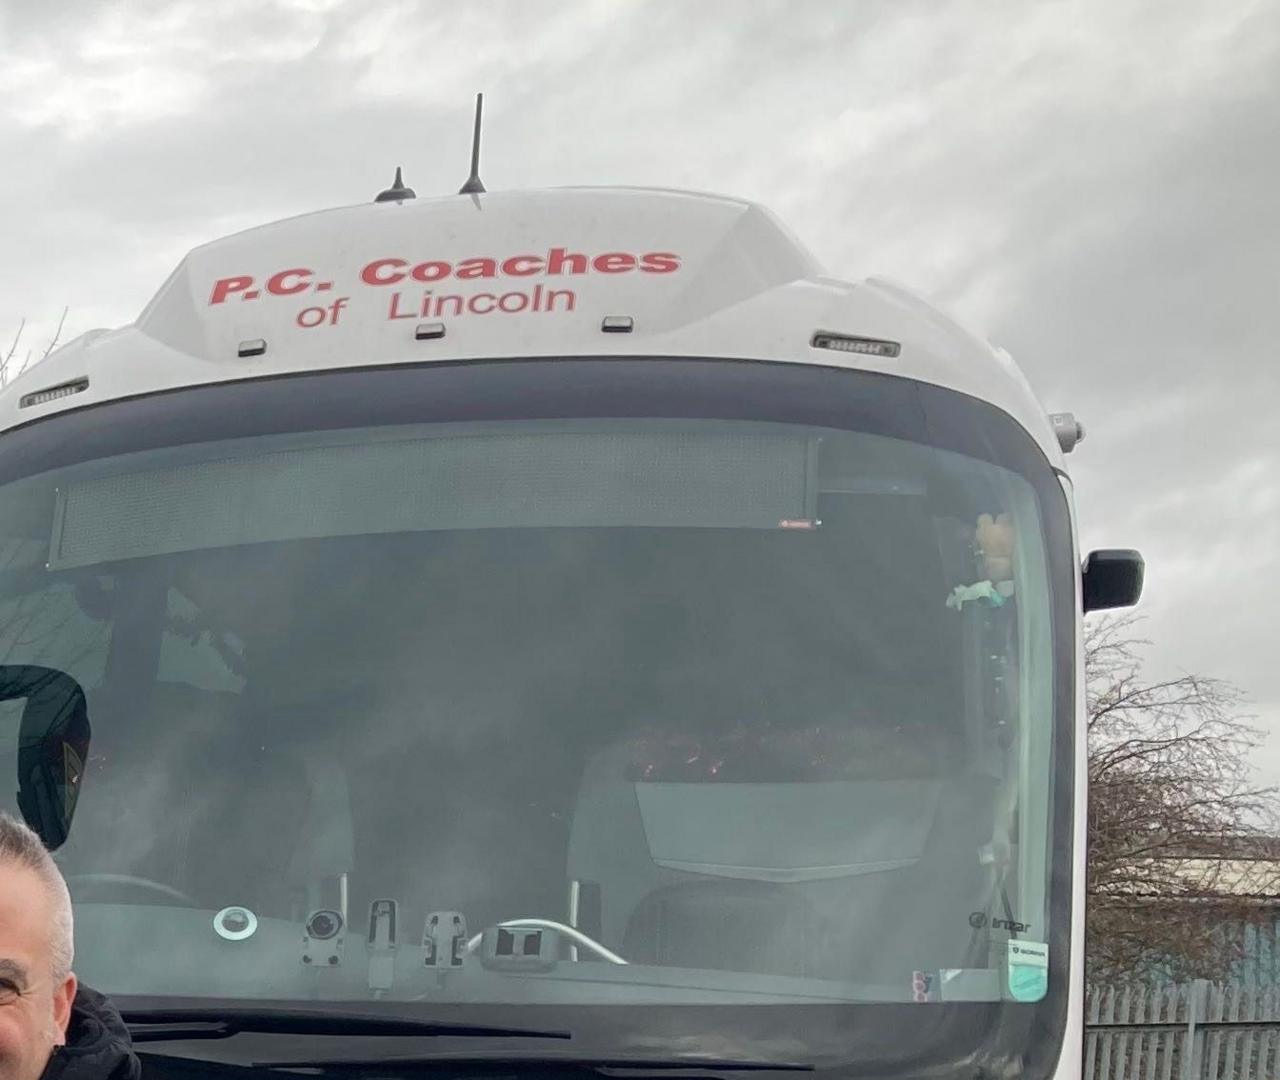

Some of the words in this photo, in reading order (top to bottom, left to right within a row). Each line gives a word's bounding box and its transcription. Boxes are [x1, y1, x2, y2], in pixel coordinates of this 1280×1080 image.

[207, 267, 333, 306] P.C.
[361, 247, 682, 287] Coaches
[296, 296, 350, 328] of
[388, 285, 577, 320] Lincoln
